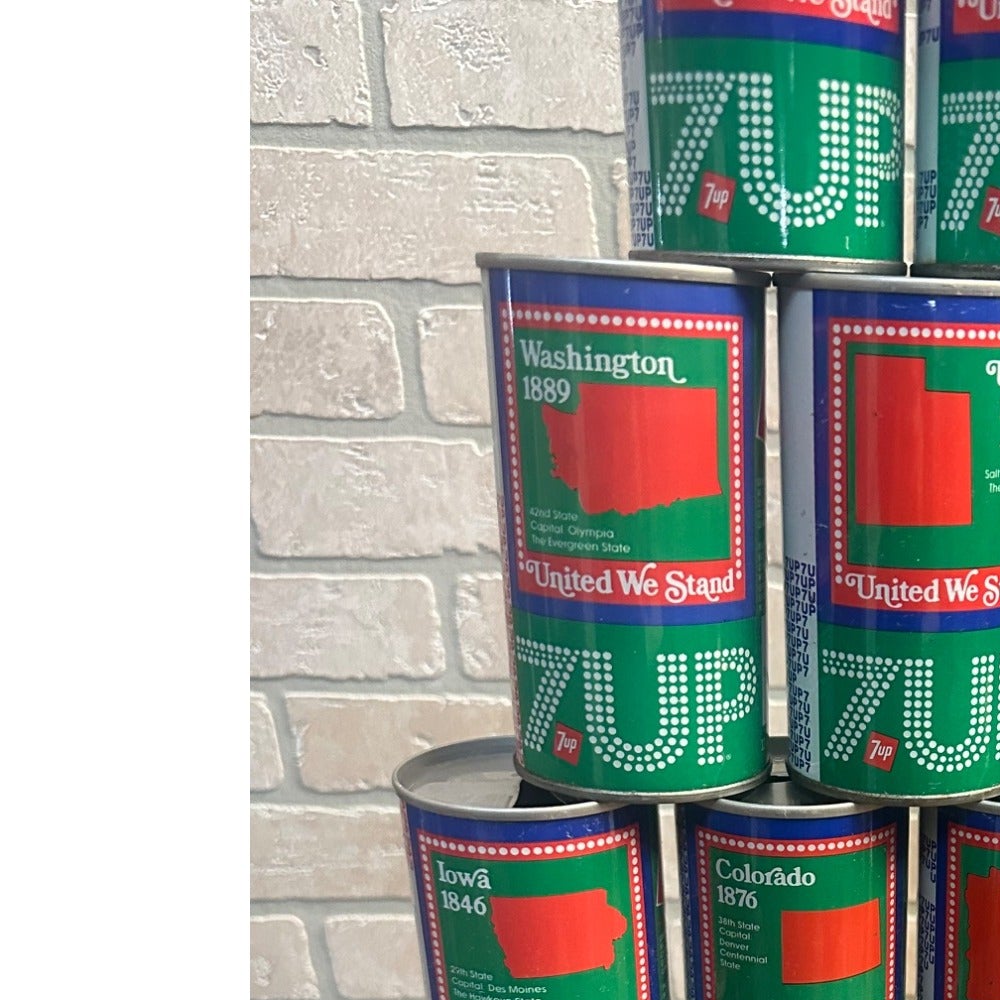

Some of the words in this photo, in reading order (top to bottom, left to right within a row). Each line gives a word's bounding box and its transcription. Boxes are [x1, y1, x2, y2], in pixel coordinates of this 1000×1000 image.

[650, 72, 899, 228] 7UP
[704, 182, 729, 209] 7up
[520, 339, 687, 383] Washington
[523, 376, 570, 403] 1889
[985, 469, 1000, 479] Salt
[553, 510, 578, 521] State
[568, 526, 614, 539] Olympia
[532, 535, 545, 545] The
[548, 537, 598, 551] Evergreen
[602, 543, 630, 553] State
[525, 560, 613, 597] United
[617, 563, 658, 596] We
[665, 569, 734, 603] Stand
[845, 573, 939, 608] United
[944, 570, 978, 601] We
[516, 636, 756, 771] 7UP
[556, 731, 578, 754] 7up
[870, 739, 892, 760] 7up
[436, 861, 491, 890] Iowa
[716, 858, 815, 886] Colorado
[441, 891, 486, 915] 1846
[717, 885, 757, 909] 1876
[738, 921, 760, 931] State
[720, 938, 748, 951] Denver
[720, 948, 767, 964] Centennial
[720, 959, 740, 969] State
[469, 970, 493, 981] State
[454, 988, 467, 998] The
[488, 984, 506, 993] Des
[509, 985, 547, 993] Moines
